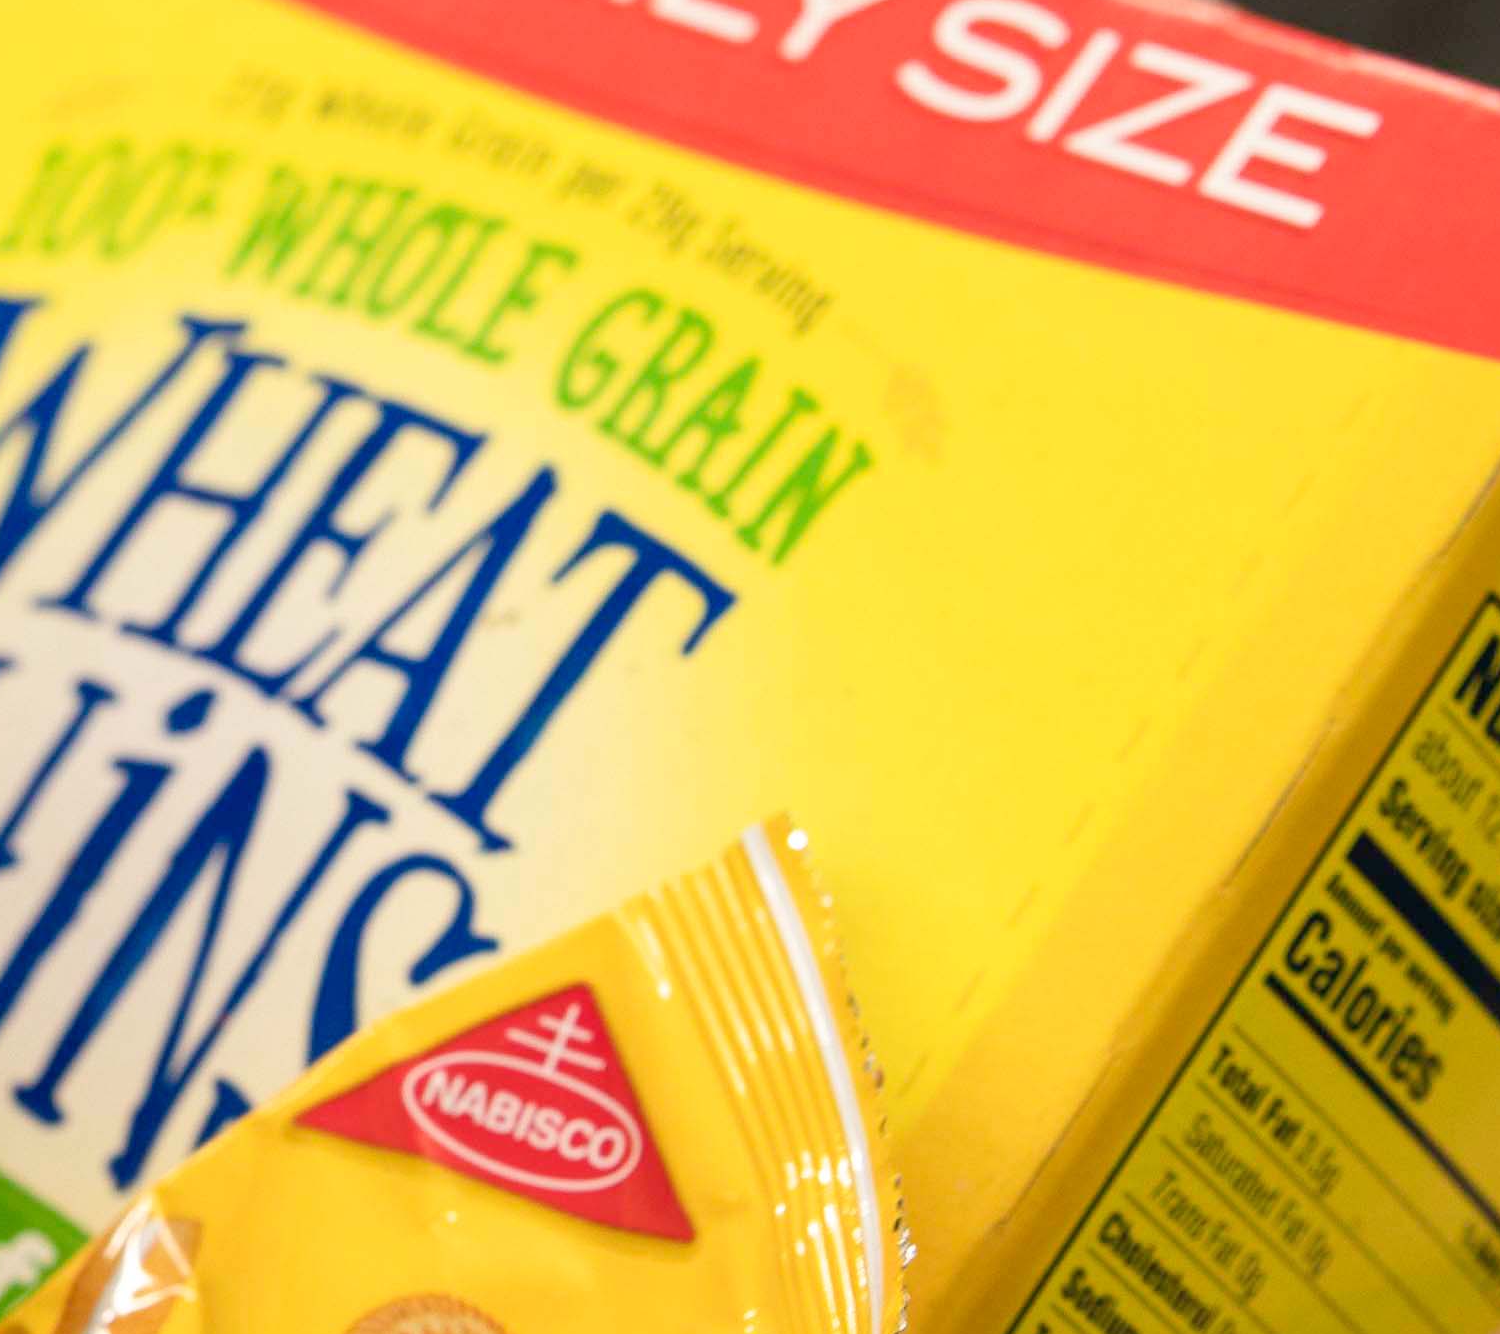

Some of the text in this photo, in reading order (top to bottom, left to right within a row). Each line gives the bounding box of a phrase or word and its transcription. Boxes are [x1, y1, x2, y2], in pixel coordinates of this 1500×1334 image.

[222, 164, 580, 364] WHOLE
[553, 289, 875, 567] GRAIN
[1413, 732, 1483, 810] about
[1379, 779, 1469, 898] Serving
[1286, 912, 1440, 1099] Calories
[420, 1066, 627, 1171] NABISCO
[1211, 1045, 1267, 1112] Total
[1262, 1099, 1300, 1147] Fat
[1153, 1171, 1209, 1240] Trans
[1207, 1222, 1241, 1268] Fat
[1185, 1114, 1279, 1216] Saturated
[1277, 1201, 1308, 1244] Fat
[1099, 1214, 1214, 1331] Cholesterol
